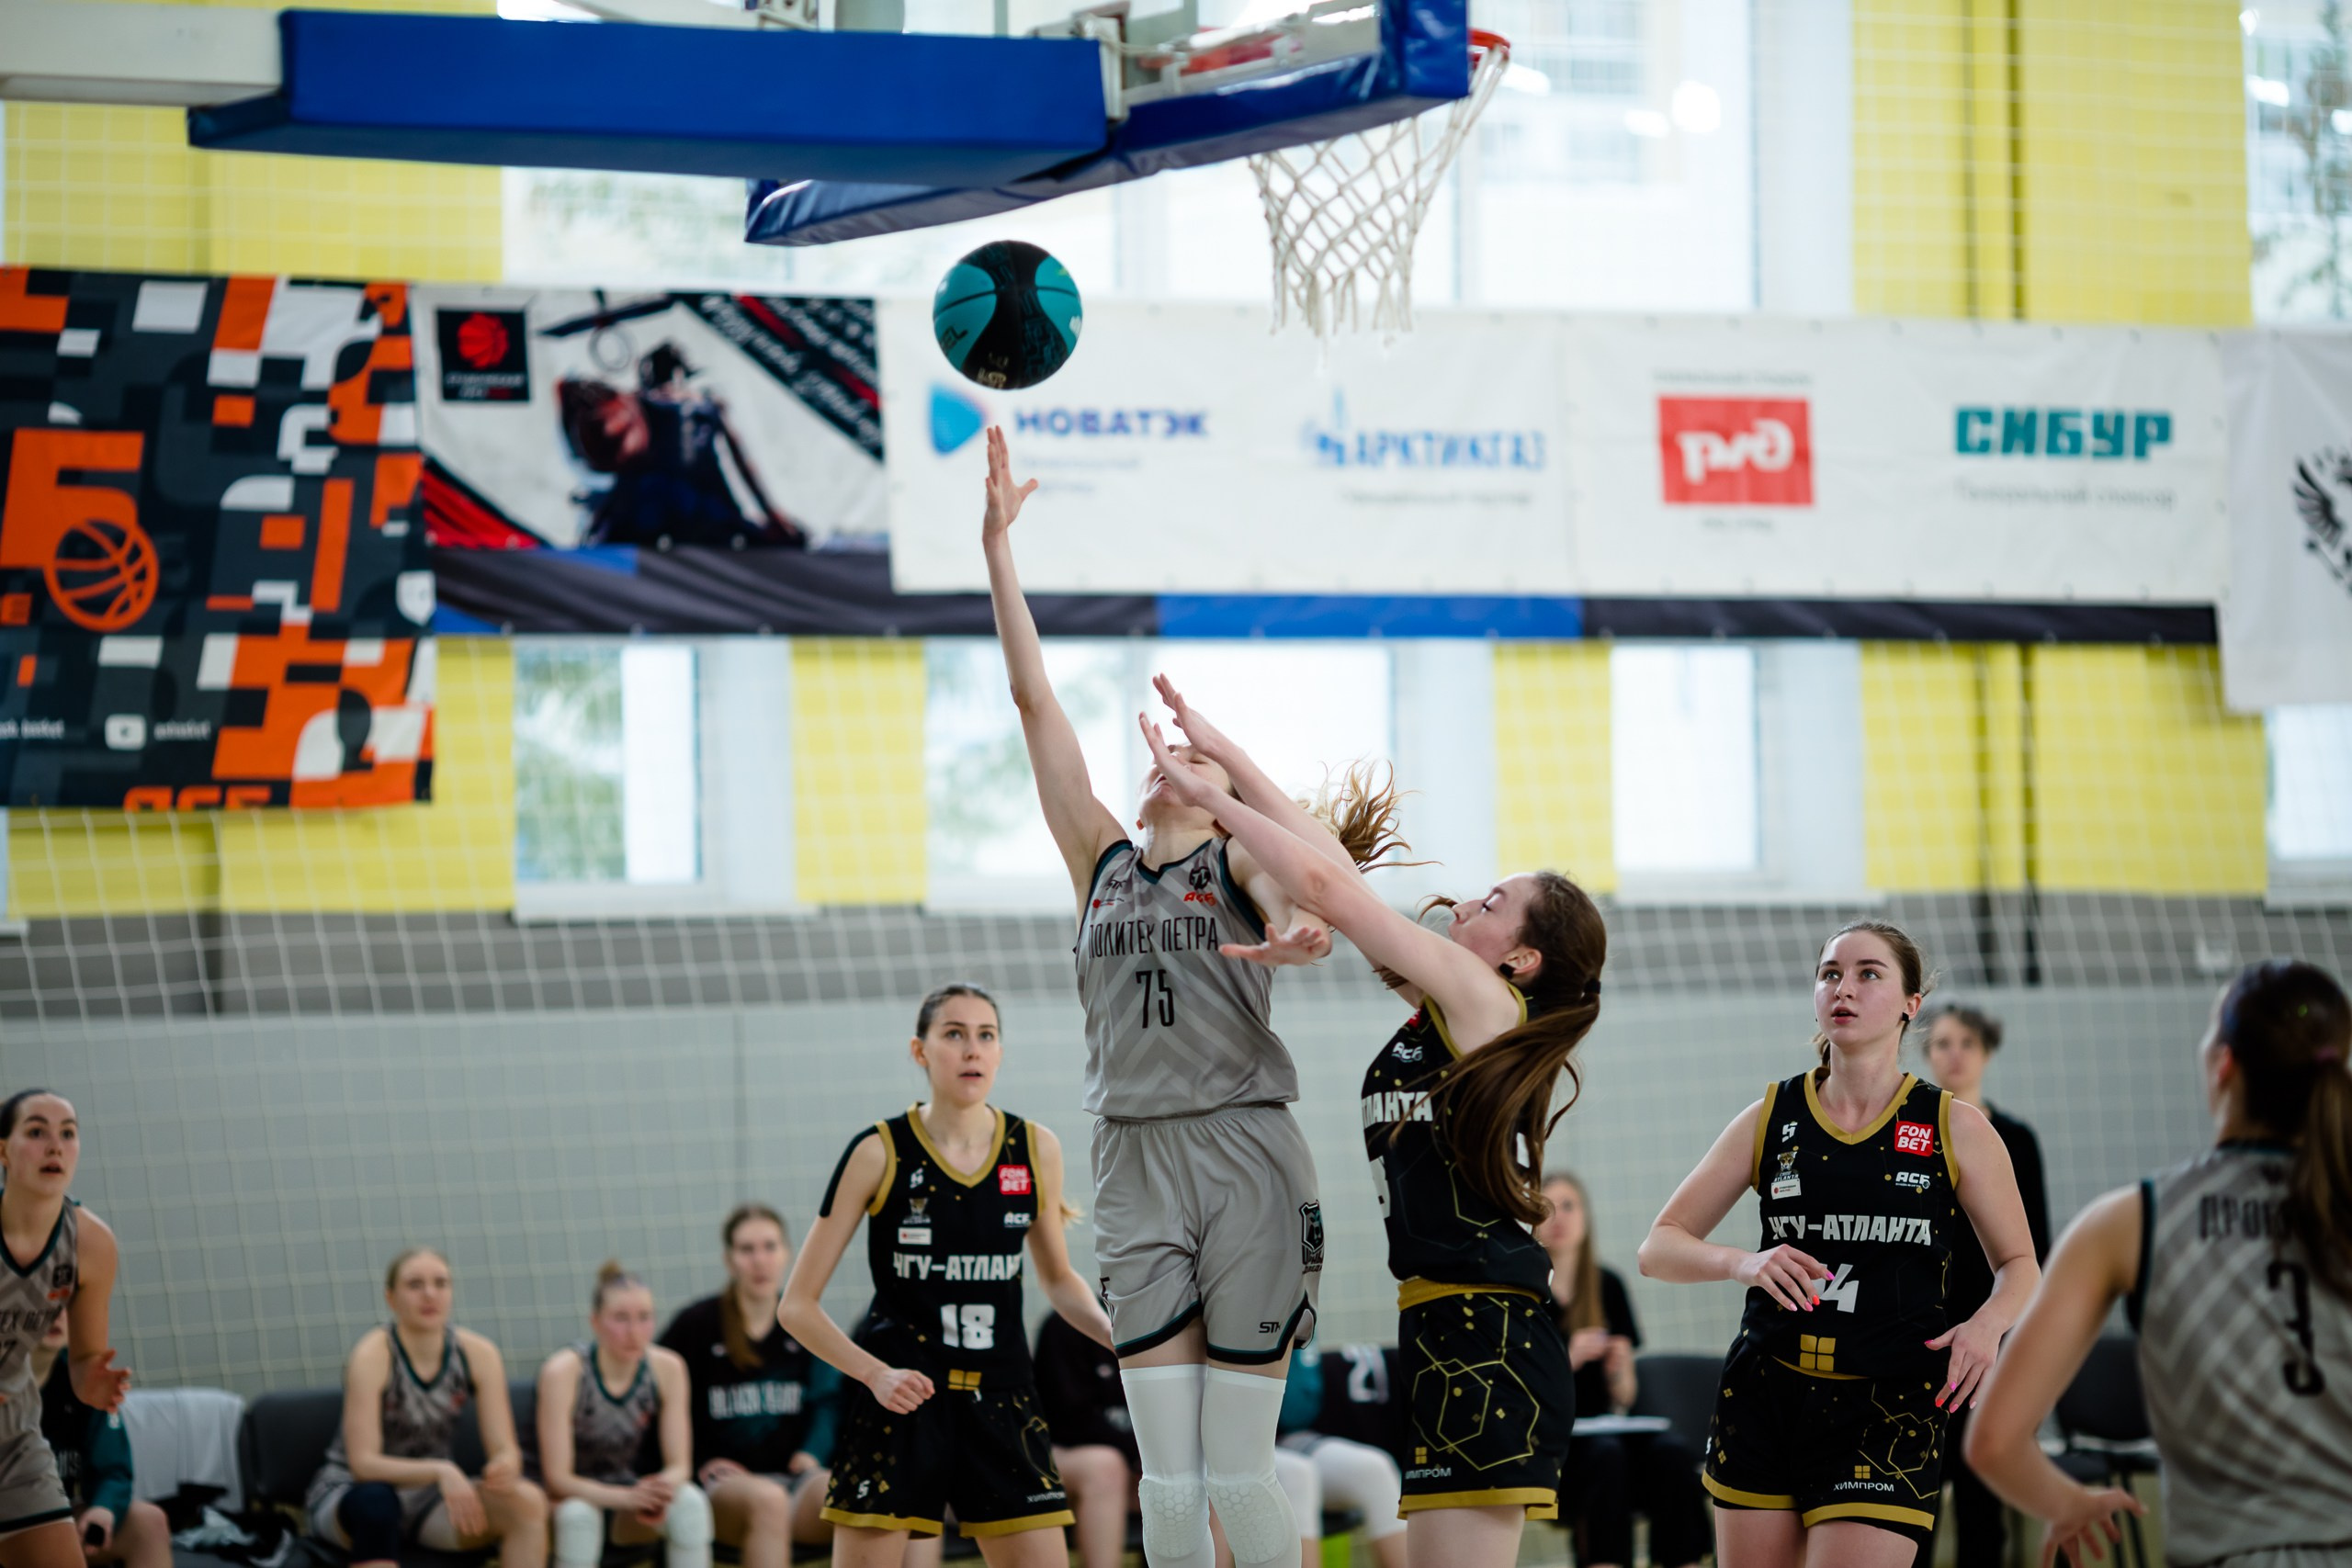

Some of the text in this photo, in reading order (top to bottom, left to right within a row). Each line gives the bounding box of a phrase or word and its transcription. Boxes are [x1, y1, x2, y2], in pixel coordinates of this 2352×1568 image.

[1015, 408, 1210, 438] НОВАТЭК
[1954, 409, 2171, 459] СИБУР
[1162, 917, 1219, 953] ПЕТРА
[1136, 969, 1175, 1029] 75
[1897, 1136, 1930, 1151] BET
[1898, 1121, 1931, 1140] FON
[940, 1303, 996, 1350] 18
